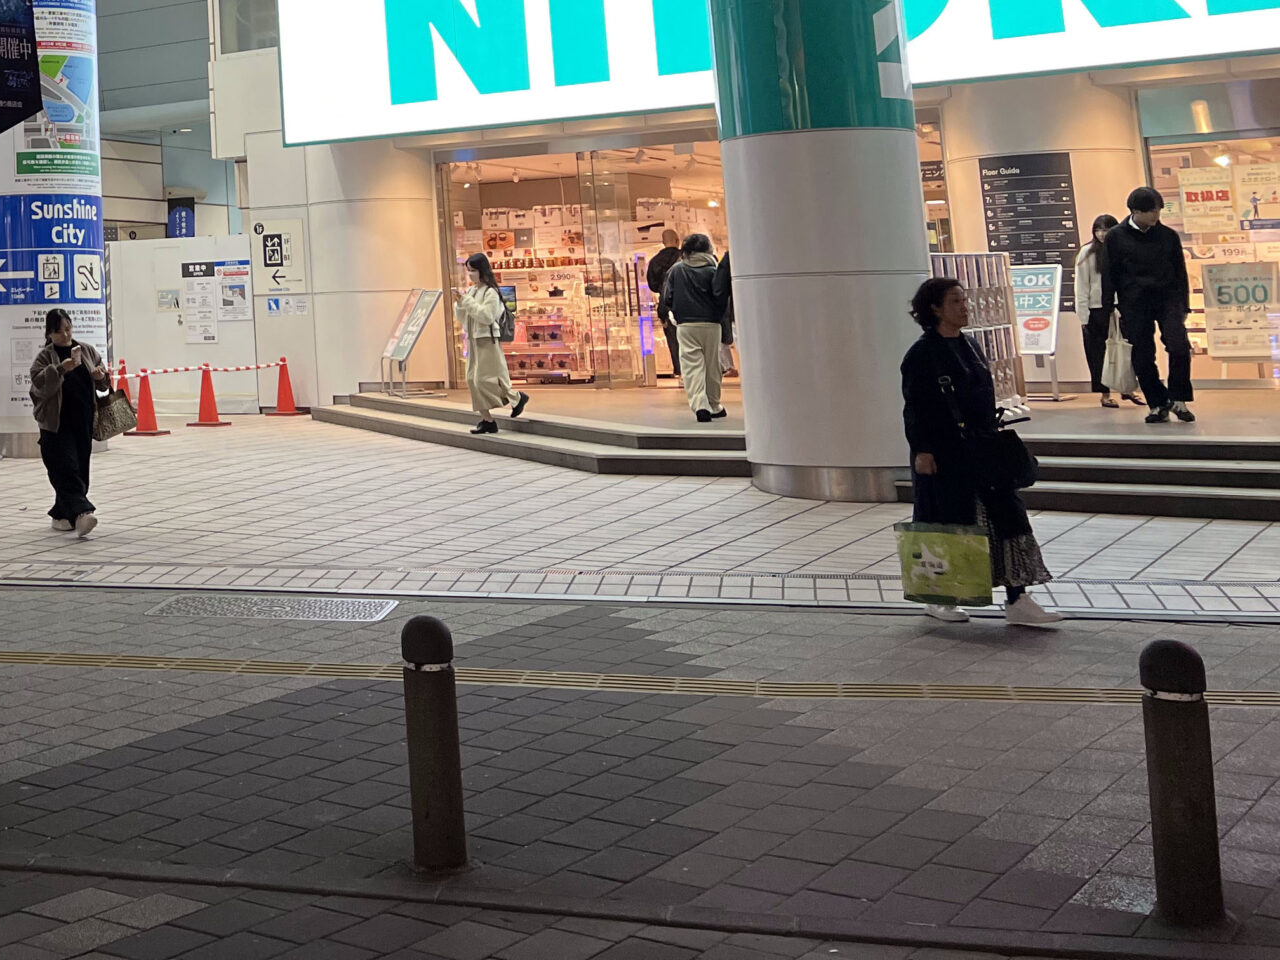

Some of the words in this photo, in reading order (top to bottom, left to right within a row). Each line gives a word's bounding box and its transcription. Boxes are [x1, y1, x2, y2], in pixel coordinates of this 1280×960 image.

[982, 168, 998, 177] Floor
[999, 167, 1020, 175] Guide
[1185, 189, 1230, 203] 取扱店
[31, 199, 97, 221] Sunshine
[51, 223, 85, 246] City
[1217, 284, 1269, 305] 500
[1236, 304, 1270, 312] ポイント
